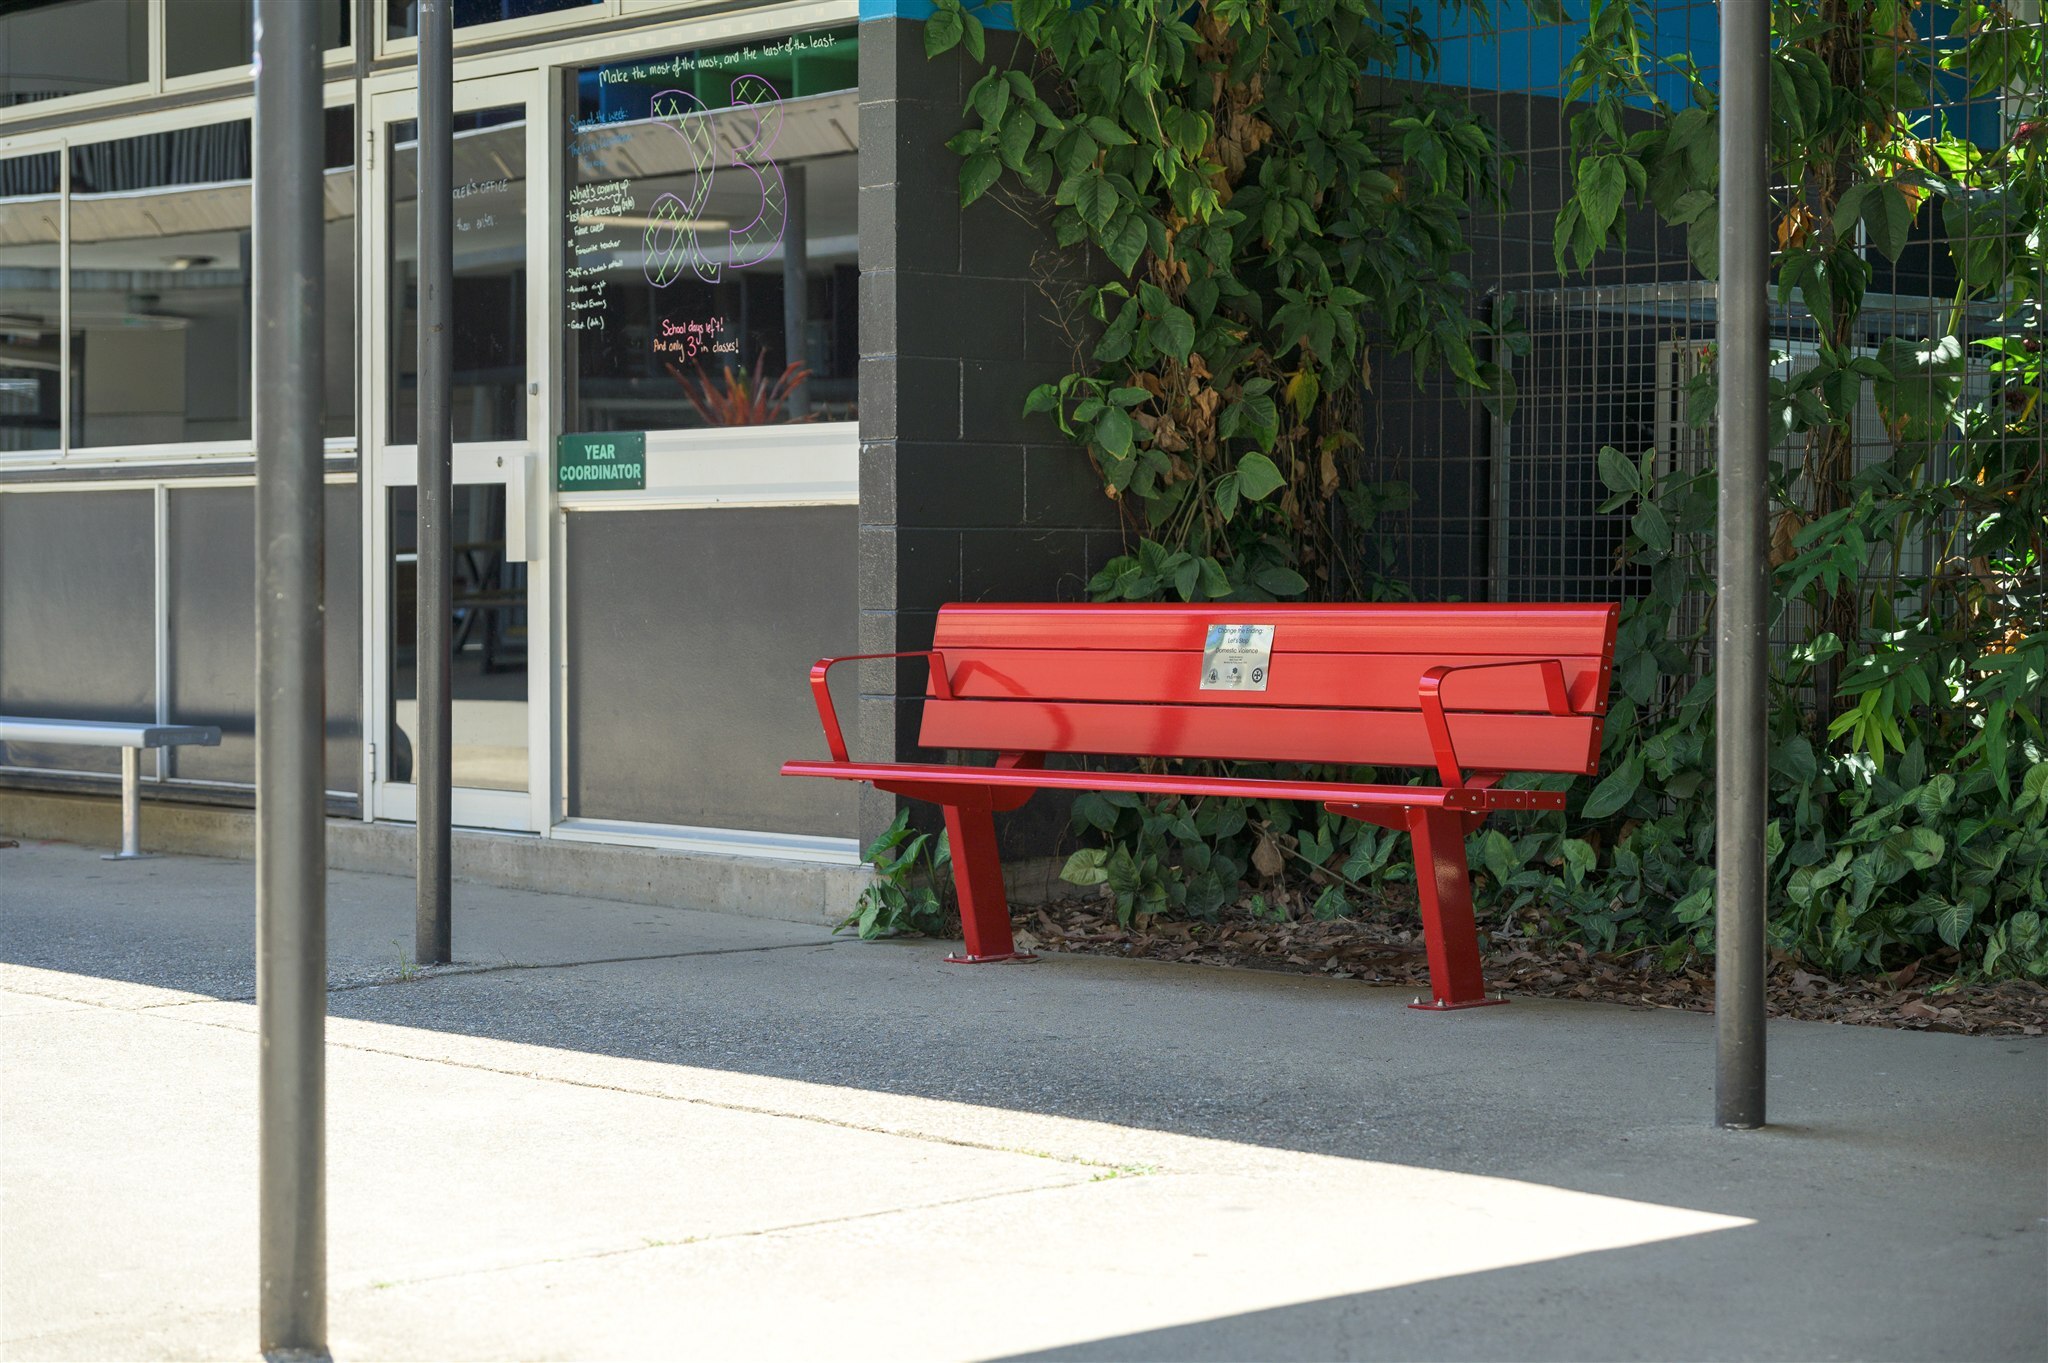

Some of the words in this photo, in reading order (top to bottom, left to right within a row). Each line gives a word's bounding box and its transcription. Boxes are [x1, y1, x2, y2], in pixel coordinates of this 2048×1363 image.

[599, 69, 629, 87] Make
[632, 66, 647, 80] the
[650, 62, 670, 76] most
[672, 56, 681, 78] of
[681, 56, 695, 70] the
[723, 51, 739, 65] and
[743, 47, 757, 61] the
[763, 42, 783, 56] least
[784, 37, 794, 55] of
[793, 39, 808, 51] the
[809, 33, 837, 48] least.
[480, 178, 508, 194] OFFICE
[570, 183, 596, 201] What's
[596, 179, 621, 204] coming
[594, 206, 610, 216] dress
[611, 204, 622, 217] day
[600, 239, 621, 249] teacher
[662, 318, 686, 336] School
[688, 320, 704, 345] days
[705, 316, 724, 339] left!
[653, 338, 666, 353] And
[668, 339, 685, 363] only
[687, 335, 697, 357] 3
[700, 342, 709, 353] in
[712, 337, 739, 354] classes!
[584, 443, 616, 460] YEAR
[559, 463, 641, 481] COORDINATOR
[1217, 627, 1237, 635] Change
